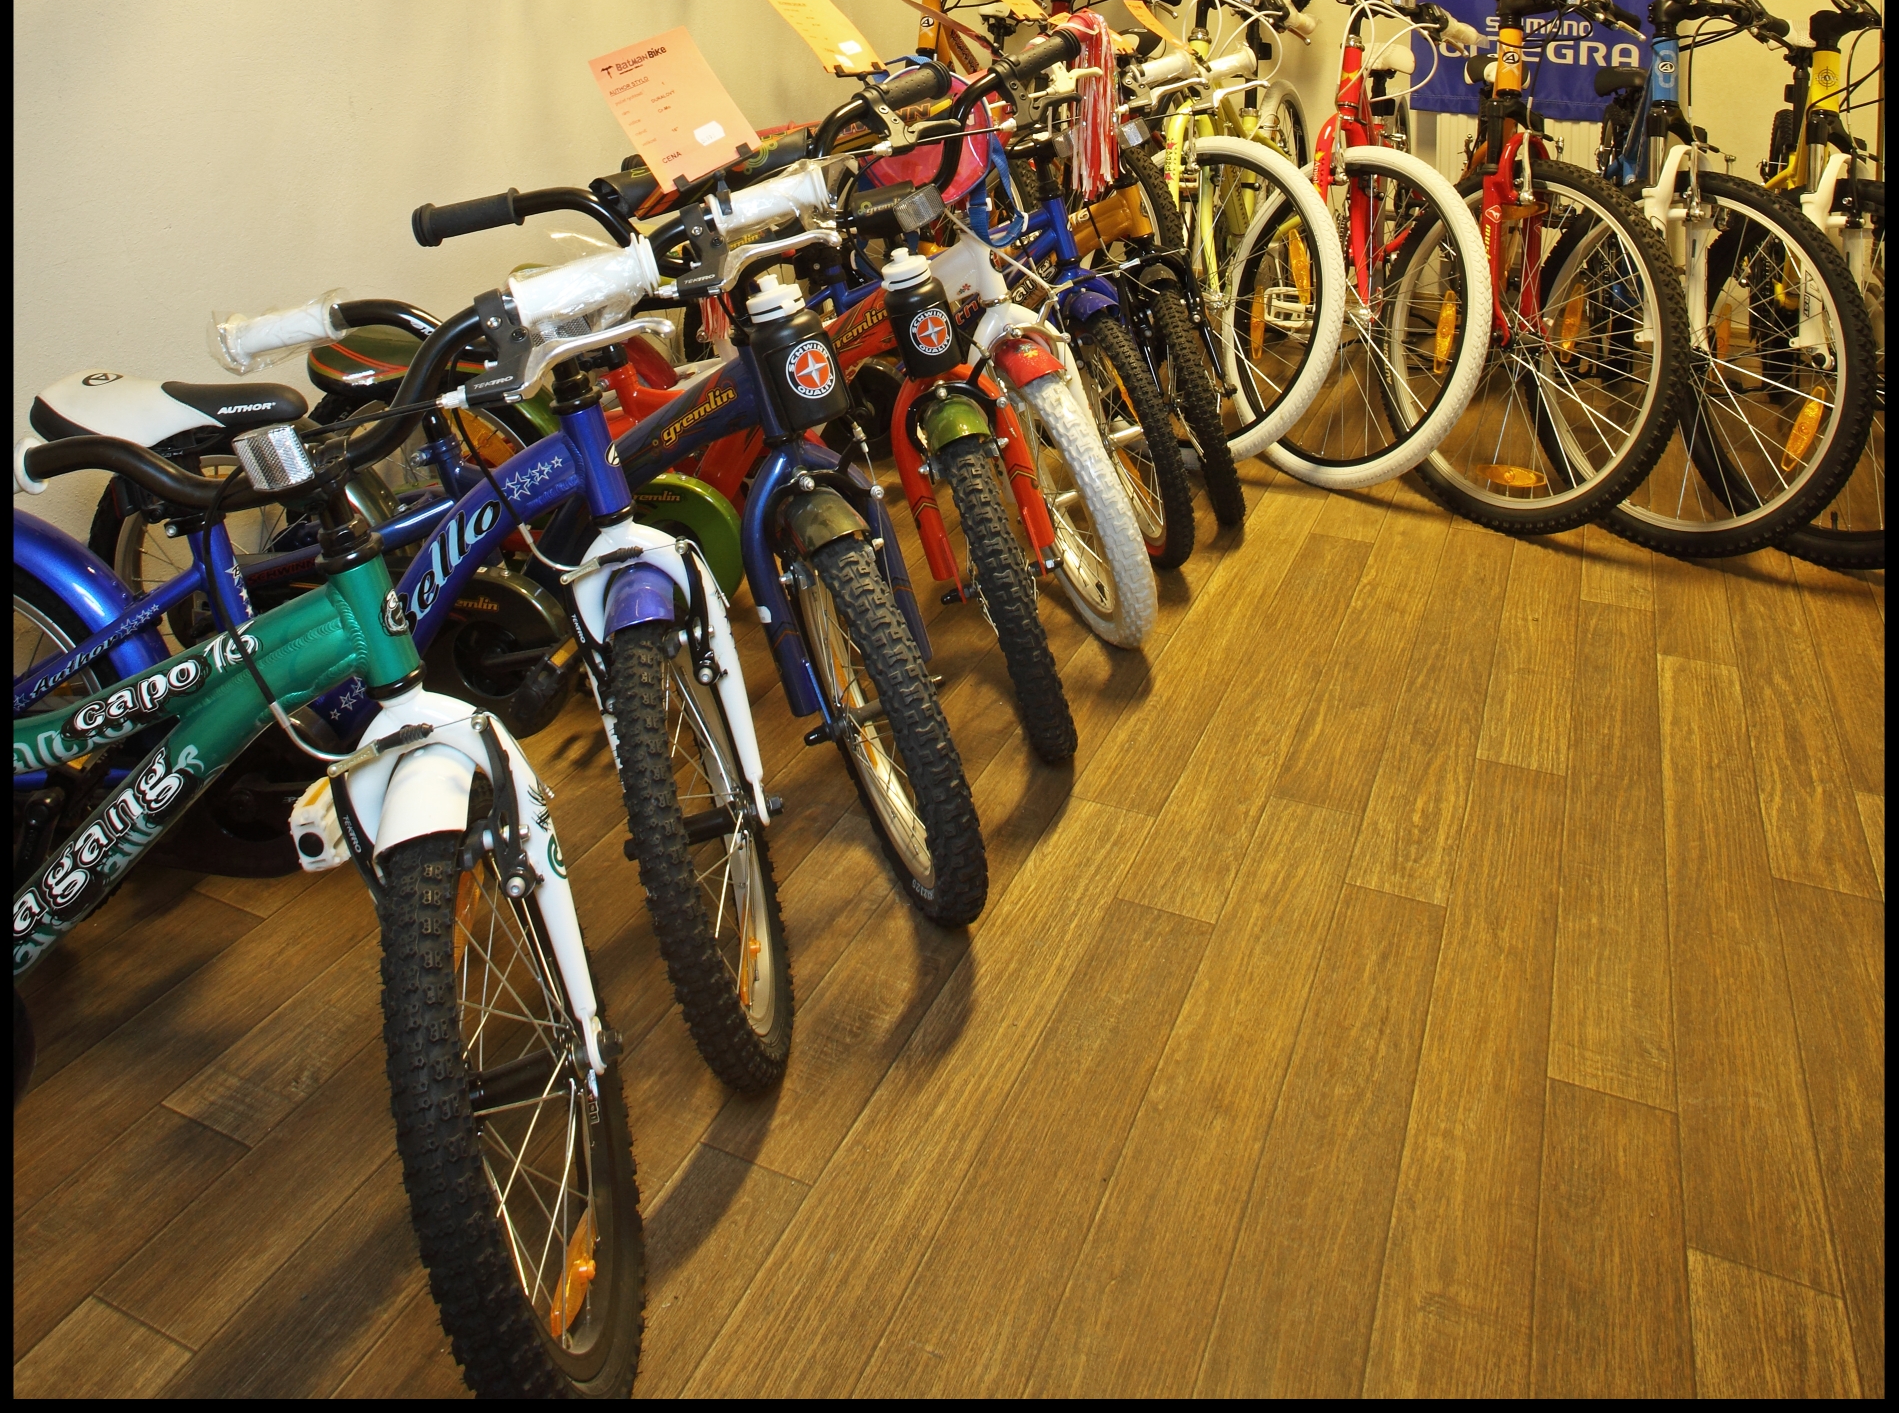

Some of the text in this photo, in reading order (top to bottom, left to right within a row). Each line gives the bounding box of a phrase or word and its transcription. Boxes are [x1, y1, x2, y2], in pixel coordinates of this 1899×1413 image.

[1486, 16, 1593, 37] SMANO
[1438, 35, 1640, 67] UEGRA
[609, 75, 650, 97] AUTHOR STYLO
[661, 150, 683, 165] CENA
[865, 197, 901, 216] greml
[728, 233, 760, 249] emlin
[683, 273, 716, 285] TEKTRO
[832, 306, 888, 351] remlin
[911, 310, 947, 334] SCHWINN
[918, 334, 951, 354] QUALITY
[788, 343, 830, 373] SCHWINN
[472, 375, 514, 390] TEKTRO
[797, 373, 835, 396] QUALITY
[217, 401, 274, 416] AUTHOR
[660, 386, 738, 448] gremlin
[632, 490, 681, 502] remlin
[455, 595, 499, 612] emlin
[571, 613, 586, 644] TEKTRO
[203, 620, 262, 674] 16
[30, 632, 119, 700] Author
[342, 814, 362, 853] TEKTRO
